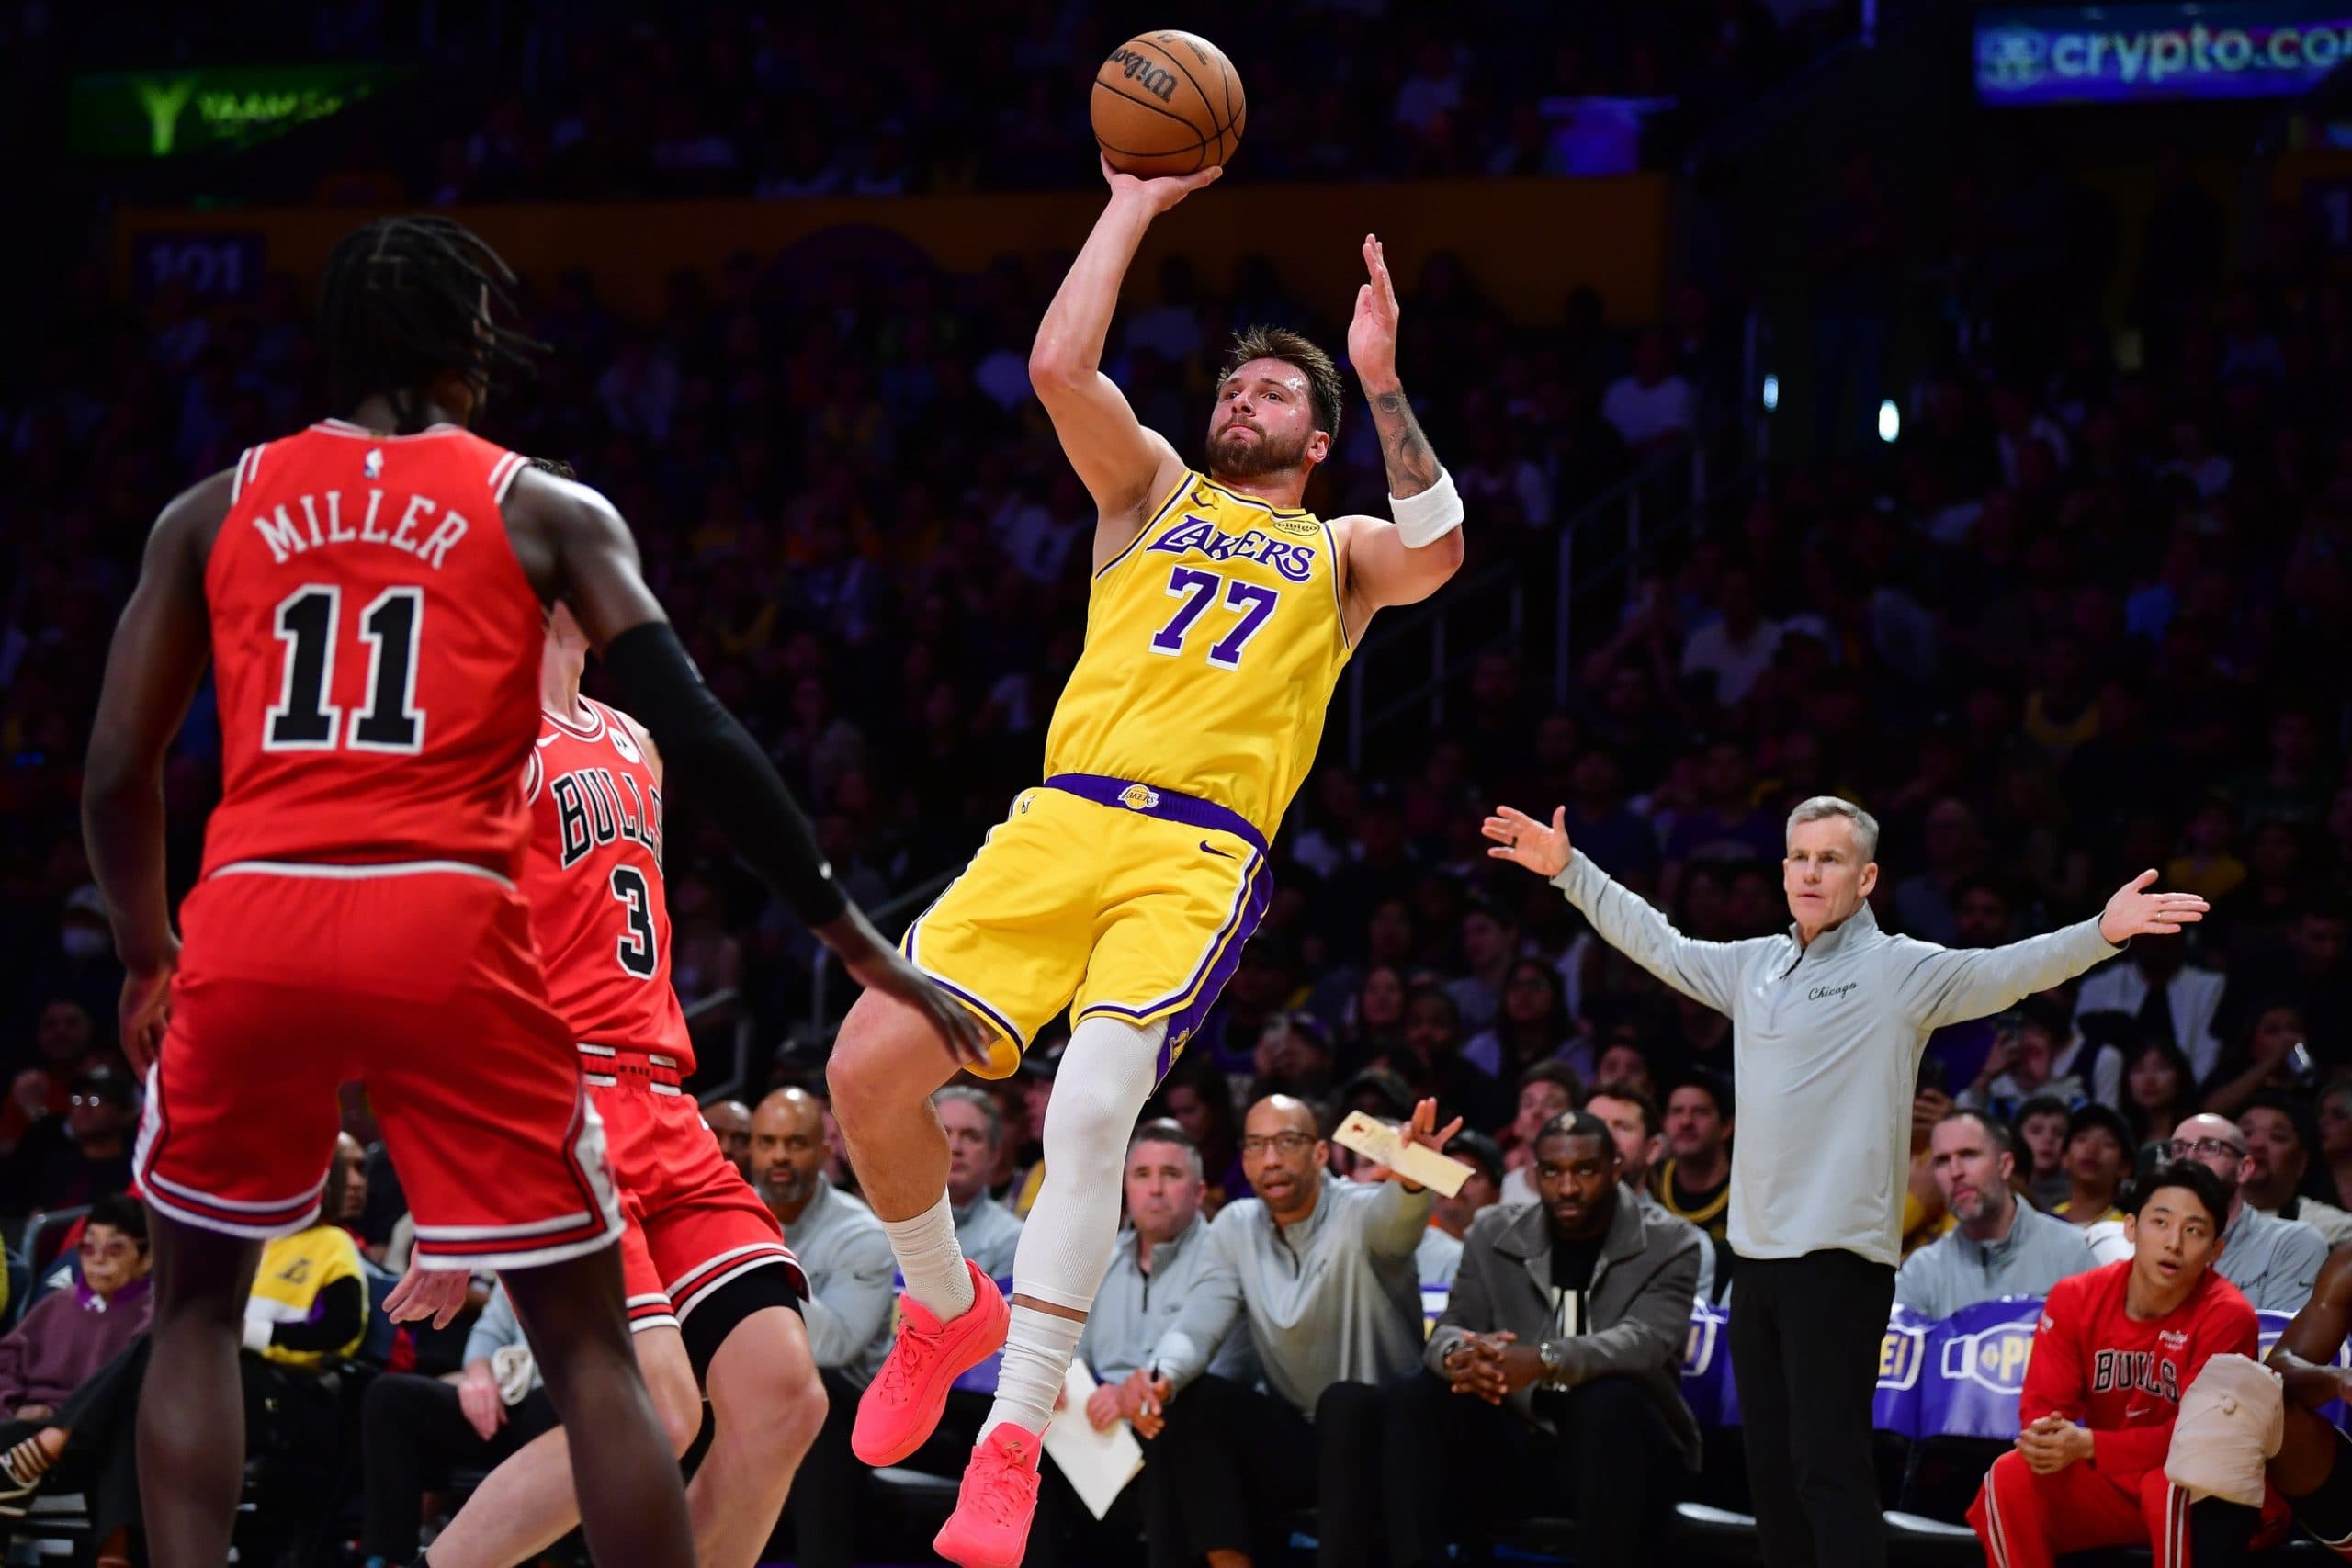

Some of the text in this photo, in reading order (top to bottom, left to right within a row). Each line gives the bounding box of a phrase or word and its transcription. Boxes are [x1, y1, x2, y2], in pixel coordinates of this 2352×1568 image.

[2051, 20, 2352, 85] crypto.co
[253, 489, 469, 570] MILLER
[1145, 514, 1317, 583] LAKERS
[1148, 565, 1281, 671] 77
[262, 583, 427, 755] 11
[1119, 785, 1159, 807] LAKERS
[610, 863, 658, 980] 3
[1808, 982, 1857, 1000] Chicago
[2094, 1348, 2179, 1404] BULLS
